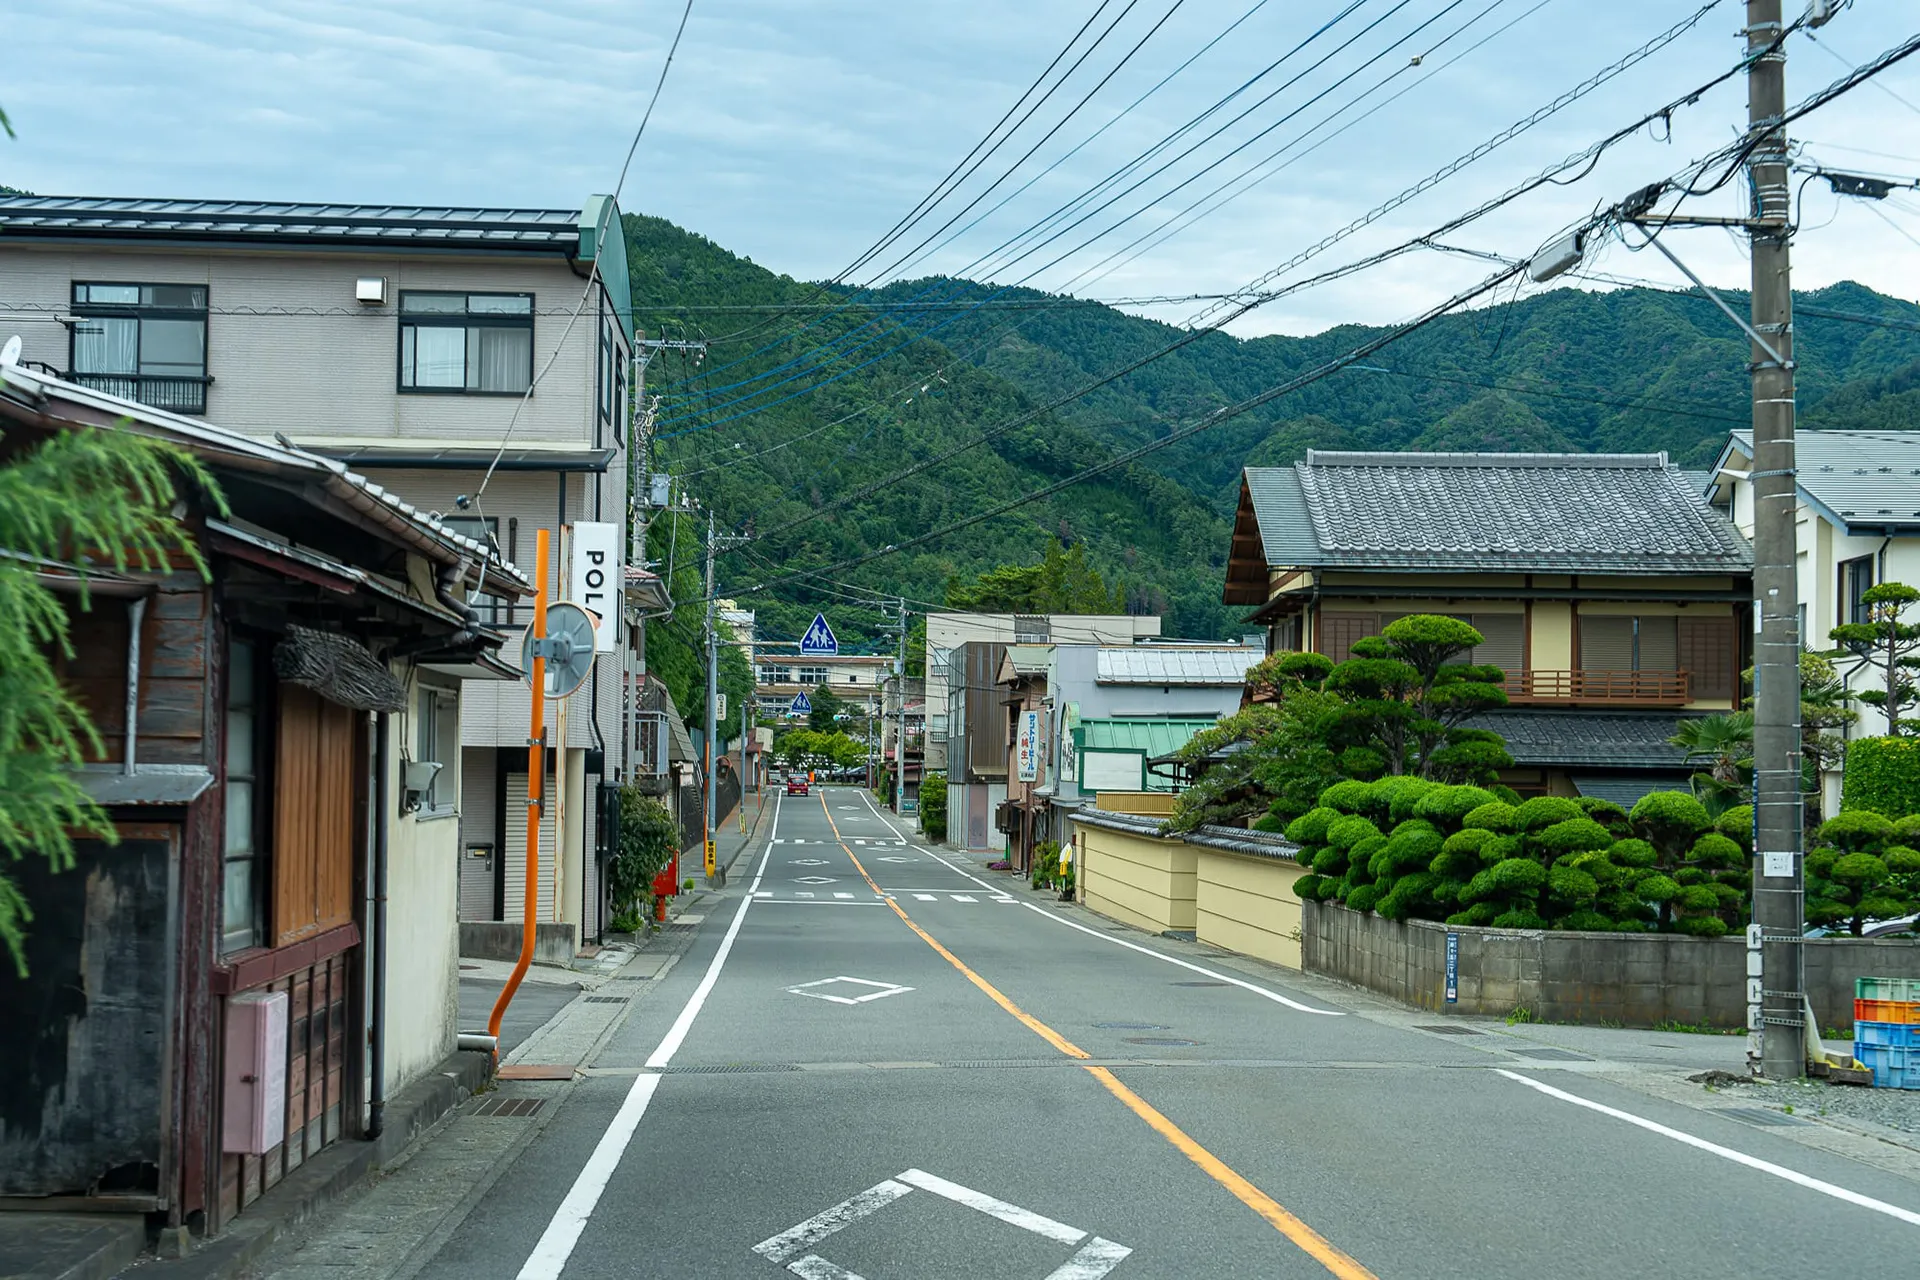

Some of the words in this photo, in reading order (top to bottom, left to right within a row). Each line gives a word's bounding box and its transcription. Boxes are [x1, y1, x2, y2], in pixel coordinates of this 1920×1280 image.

[1028, 713, 1036, 770] サントリービール
